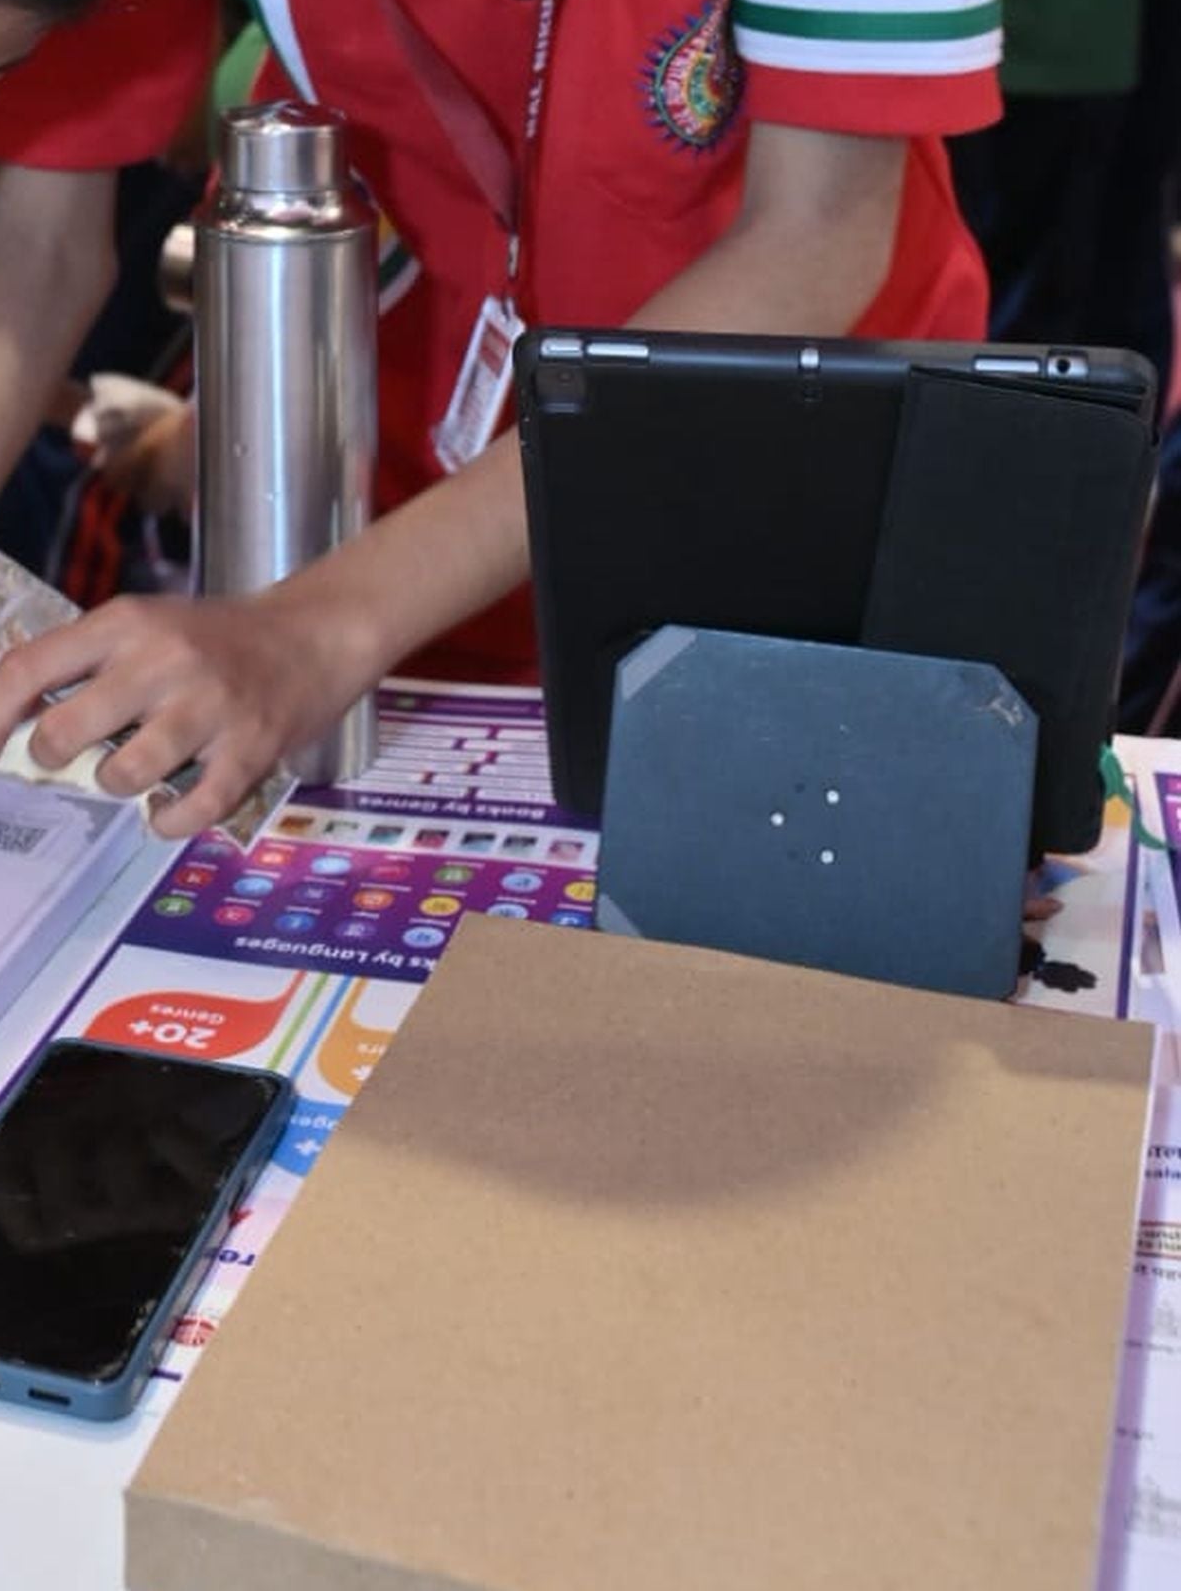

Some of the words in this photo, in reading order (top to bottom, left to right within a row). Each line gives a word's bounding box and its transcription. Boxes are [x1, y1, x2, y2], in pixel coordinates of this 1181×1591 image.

[235, 935, 369, 964] Languages
[374, 950, 404, 969] by
[150, 1003, 225, 1025] Genres
[127, 1019, 216, 1050] 20+
